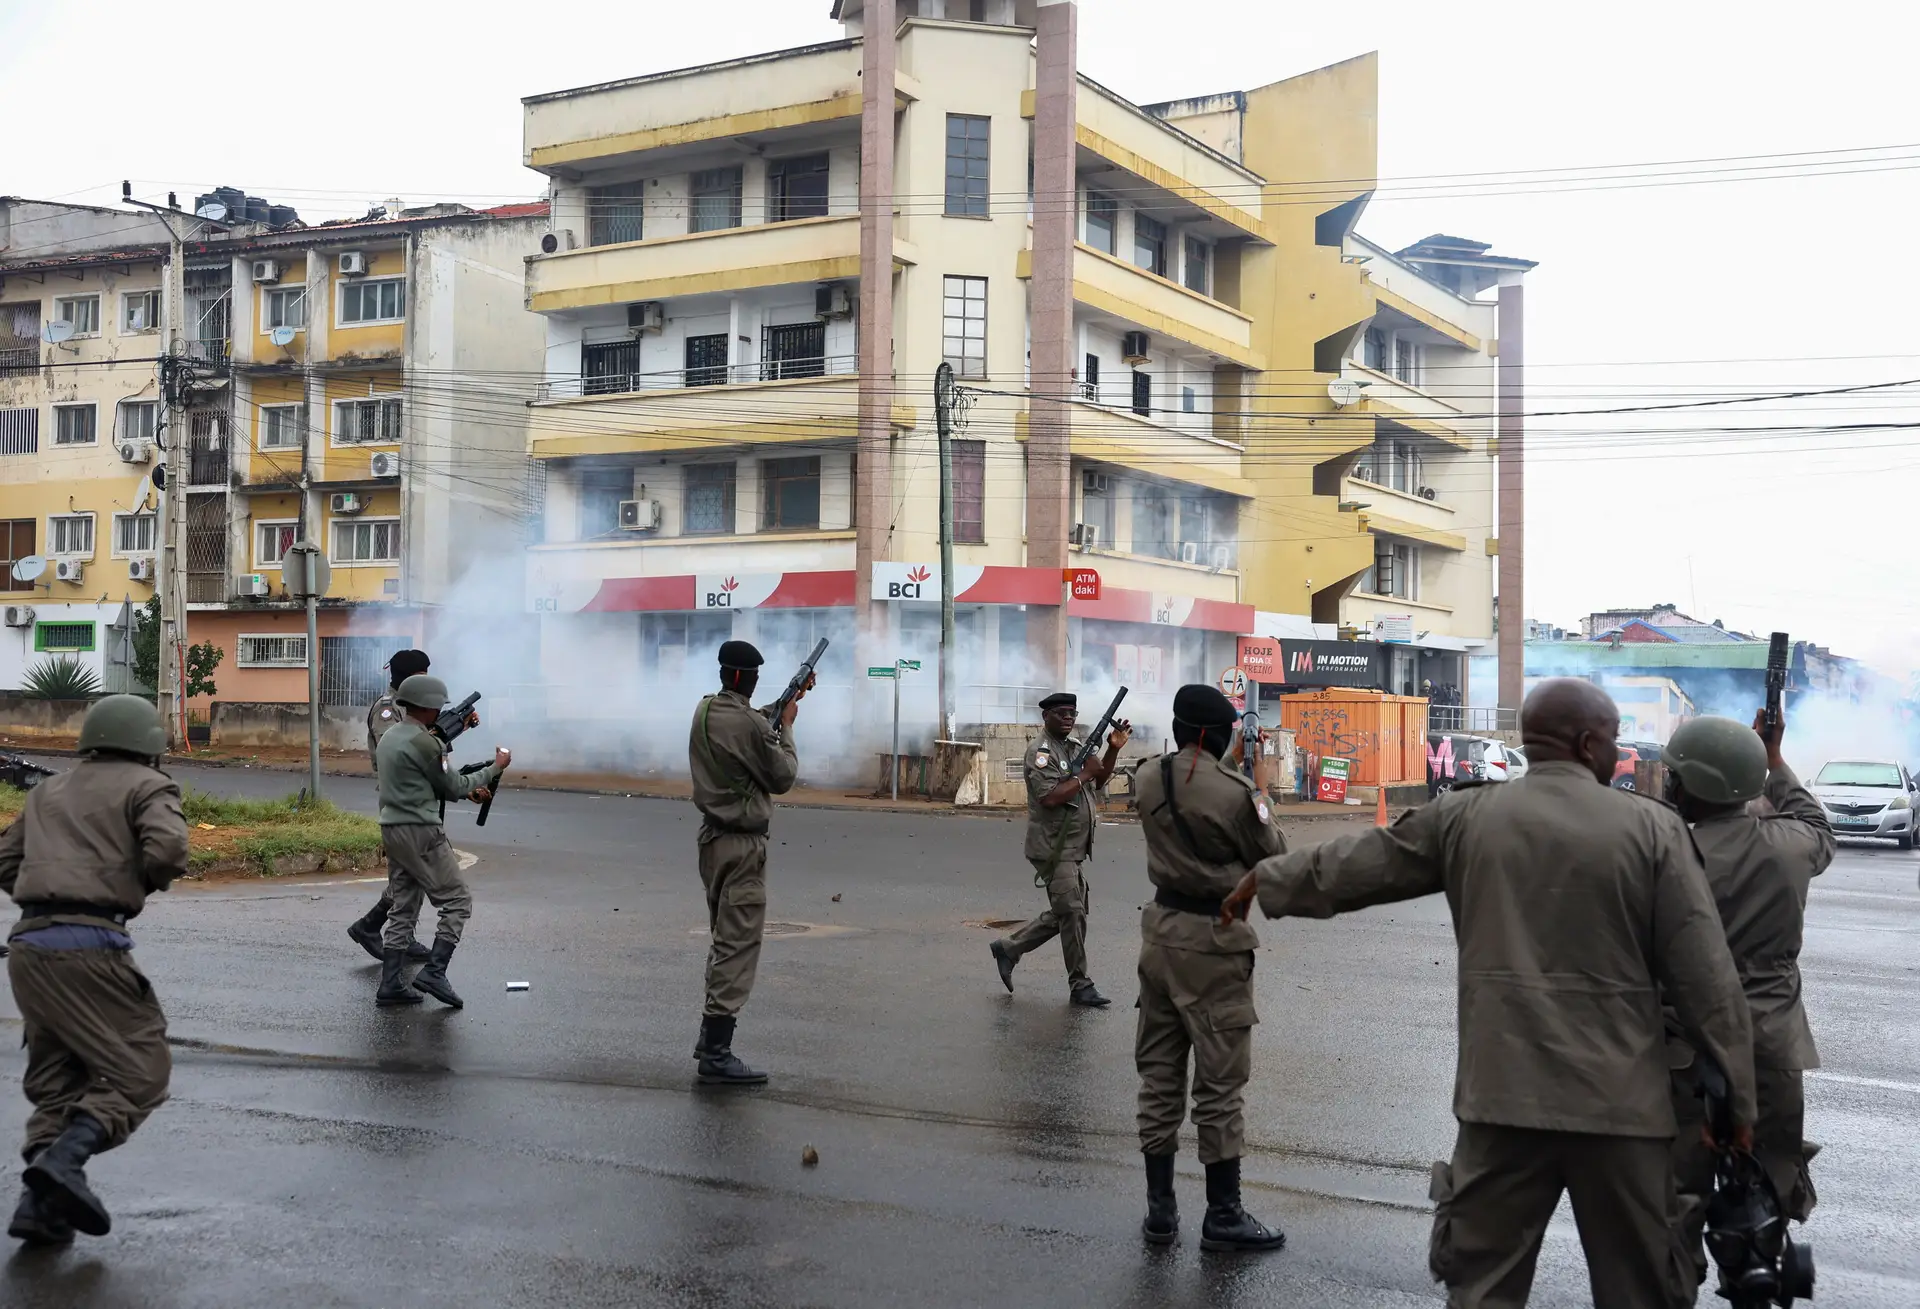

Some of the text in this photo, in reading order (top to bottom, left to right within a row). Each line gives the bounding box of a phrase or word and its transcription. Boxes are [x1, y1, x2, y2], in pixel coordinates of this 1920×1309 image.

[1076, 574, 1096, 583] ATM
[888, 582, 921, 599] BCI
[1075, 585, 1096, 595] daki
[534, 598, 558, 611] BCI
[706, 592, 731, 607] BCI
[1156, 609, 1170, 623] BCI
[1244, 646, 1273, 656] HOJE
[1265, 657, 1273, 665] DE
[1317, 655, 1369, 666] IN MOTION
[1244, 665, 1273, 674] TREINO
[1316, 665, 1368, 673] PERFORMANCE
[1312, 692, 1331, 700] 385
